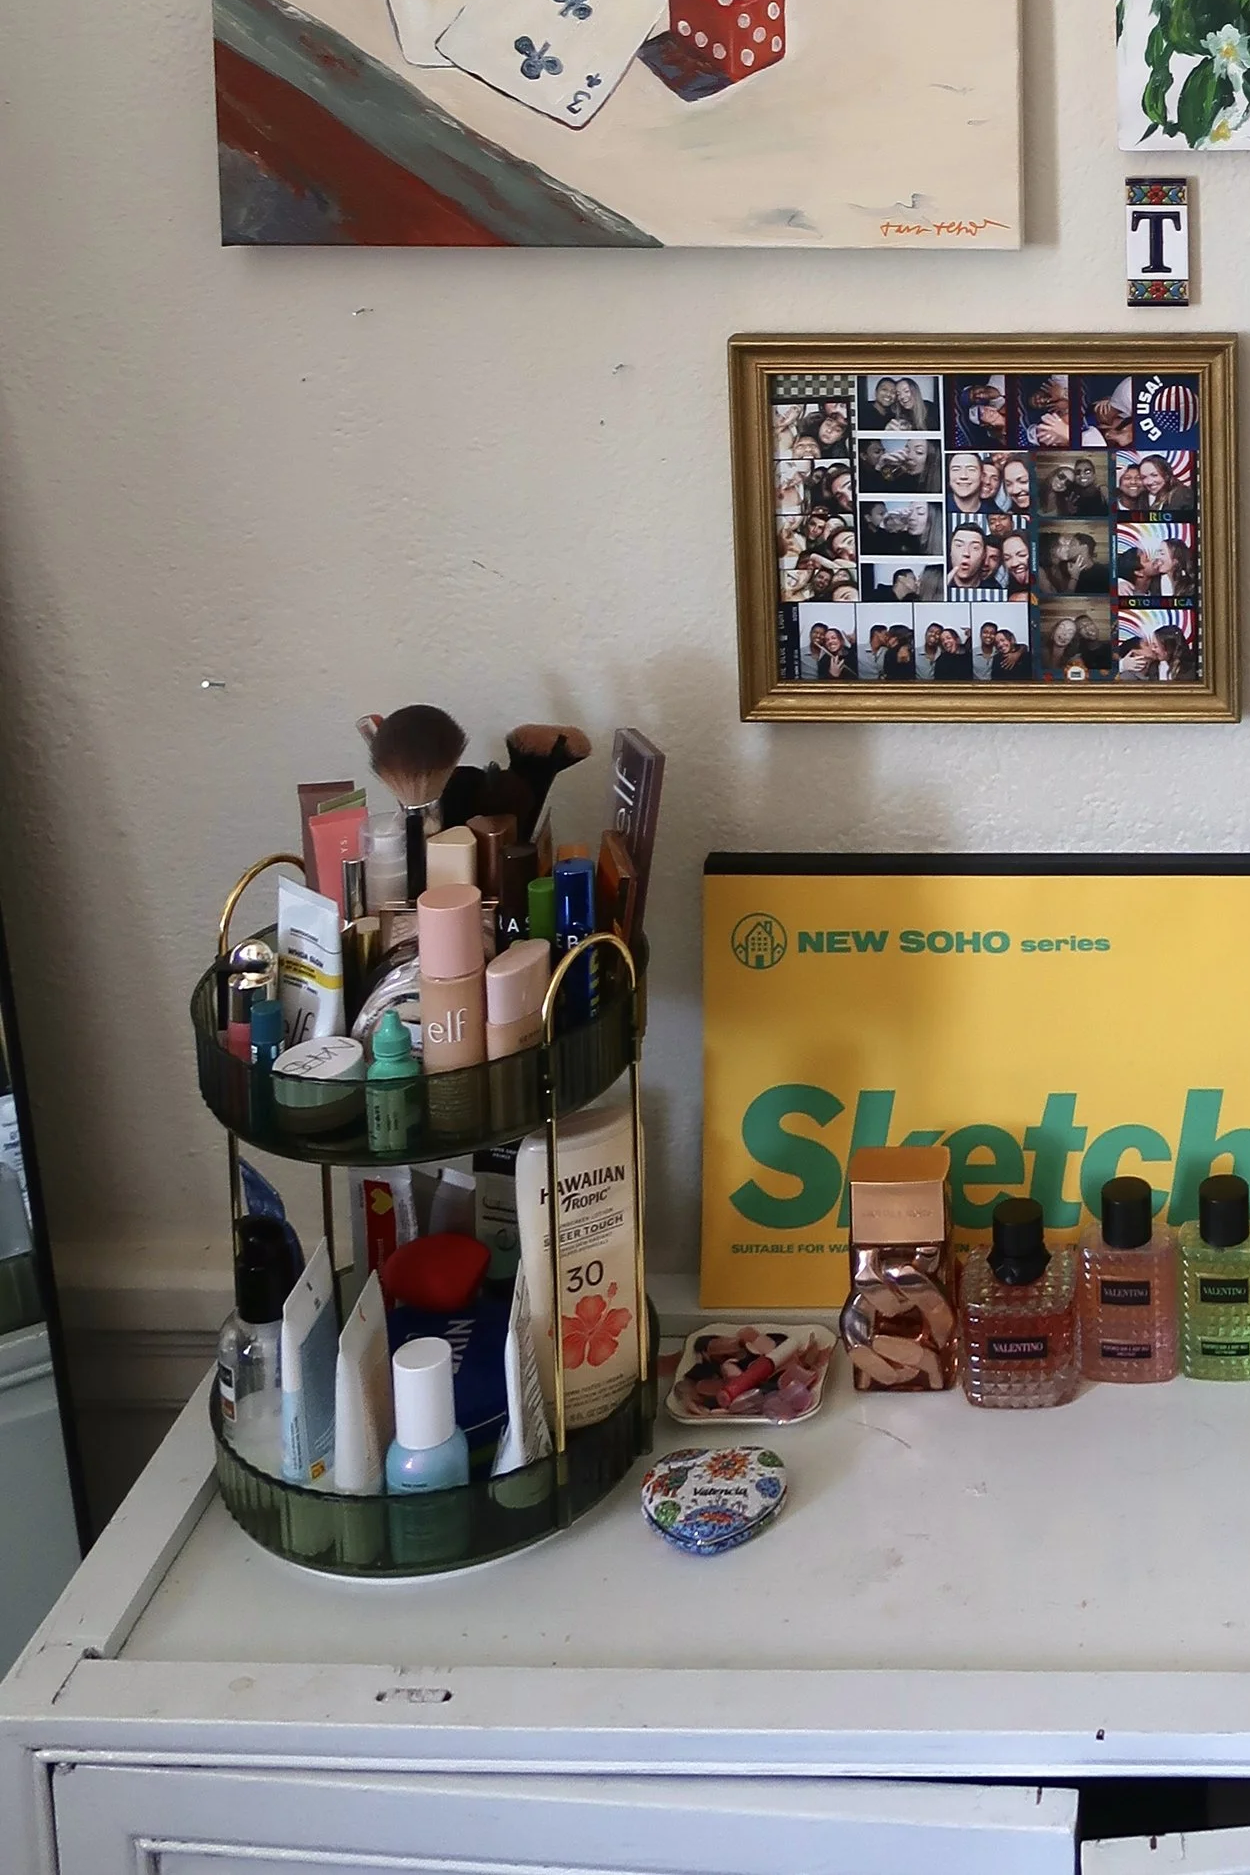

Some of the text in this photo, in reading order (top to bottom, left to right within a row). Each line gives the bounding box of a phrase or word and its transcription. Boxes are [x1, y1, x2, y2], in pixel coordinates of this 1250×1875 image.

[566, 90, 591, 114] 3
[1131, 211, 1181, 273] T
[1136, 375, 1164, 442] GO USA!
[797, 929, 1112, 955] NEW SOHO series
[282, 1039, 355, 1075] NARS
[540, 1165, 625, 1205] HAWAIIAN
[544, 1231, 581, 1247] SEER
[584, 1213, 625, 1234] TOUCH
[731, 1244, 850, 1254] SUITABLE FOR WA
[566, 1259, 604, 1293] 30
[1103, 1287, 1148, 1298] VALENTINO
[1203, 1286, 1247, 1296] VALENTINO
[993, 1342, 1044, 1353] VALENTINO
[693, 1486, 748, 1497] Valencia
